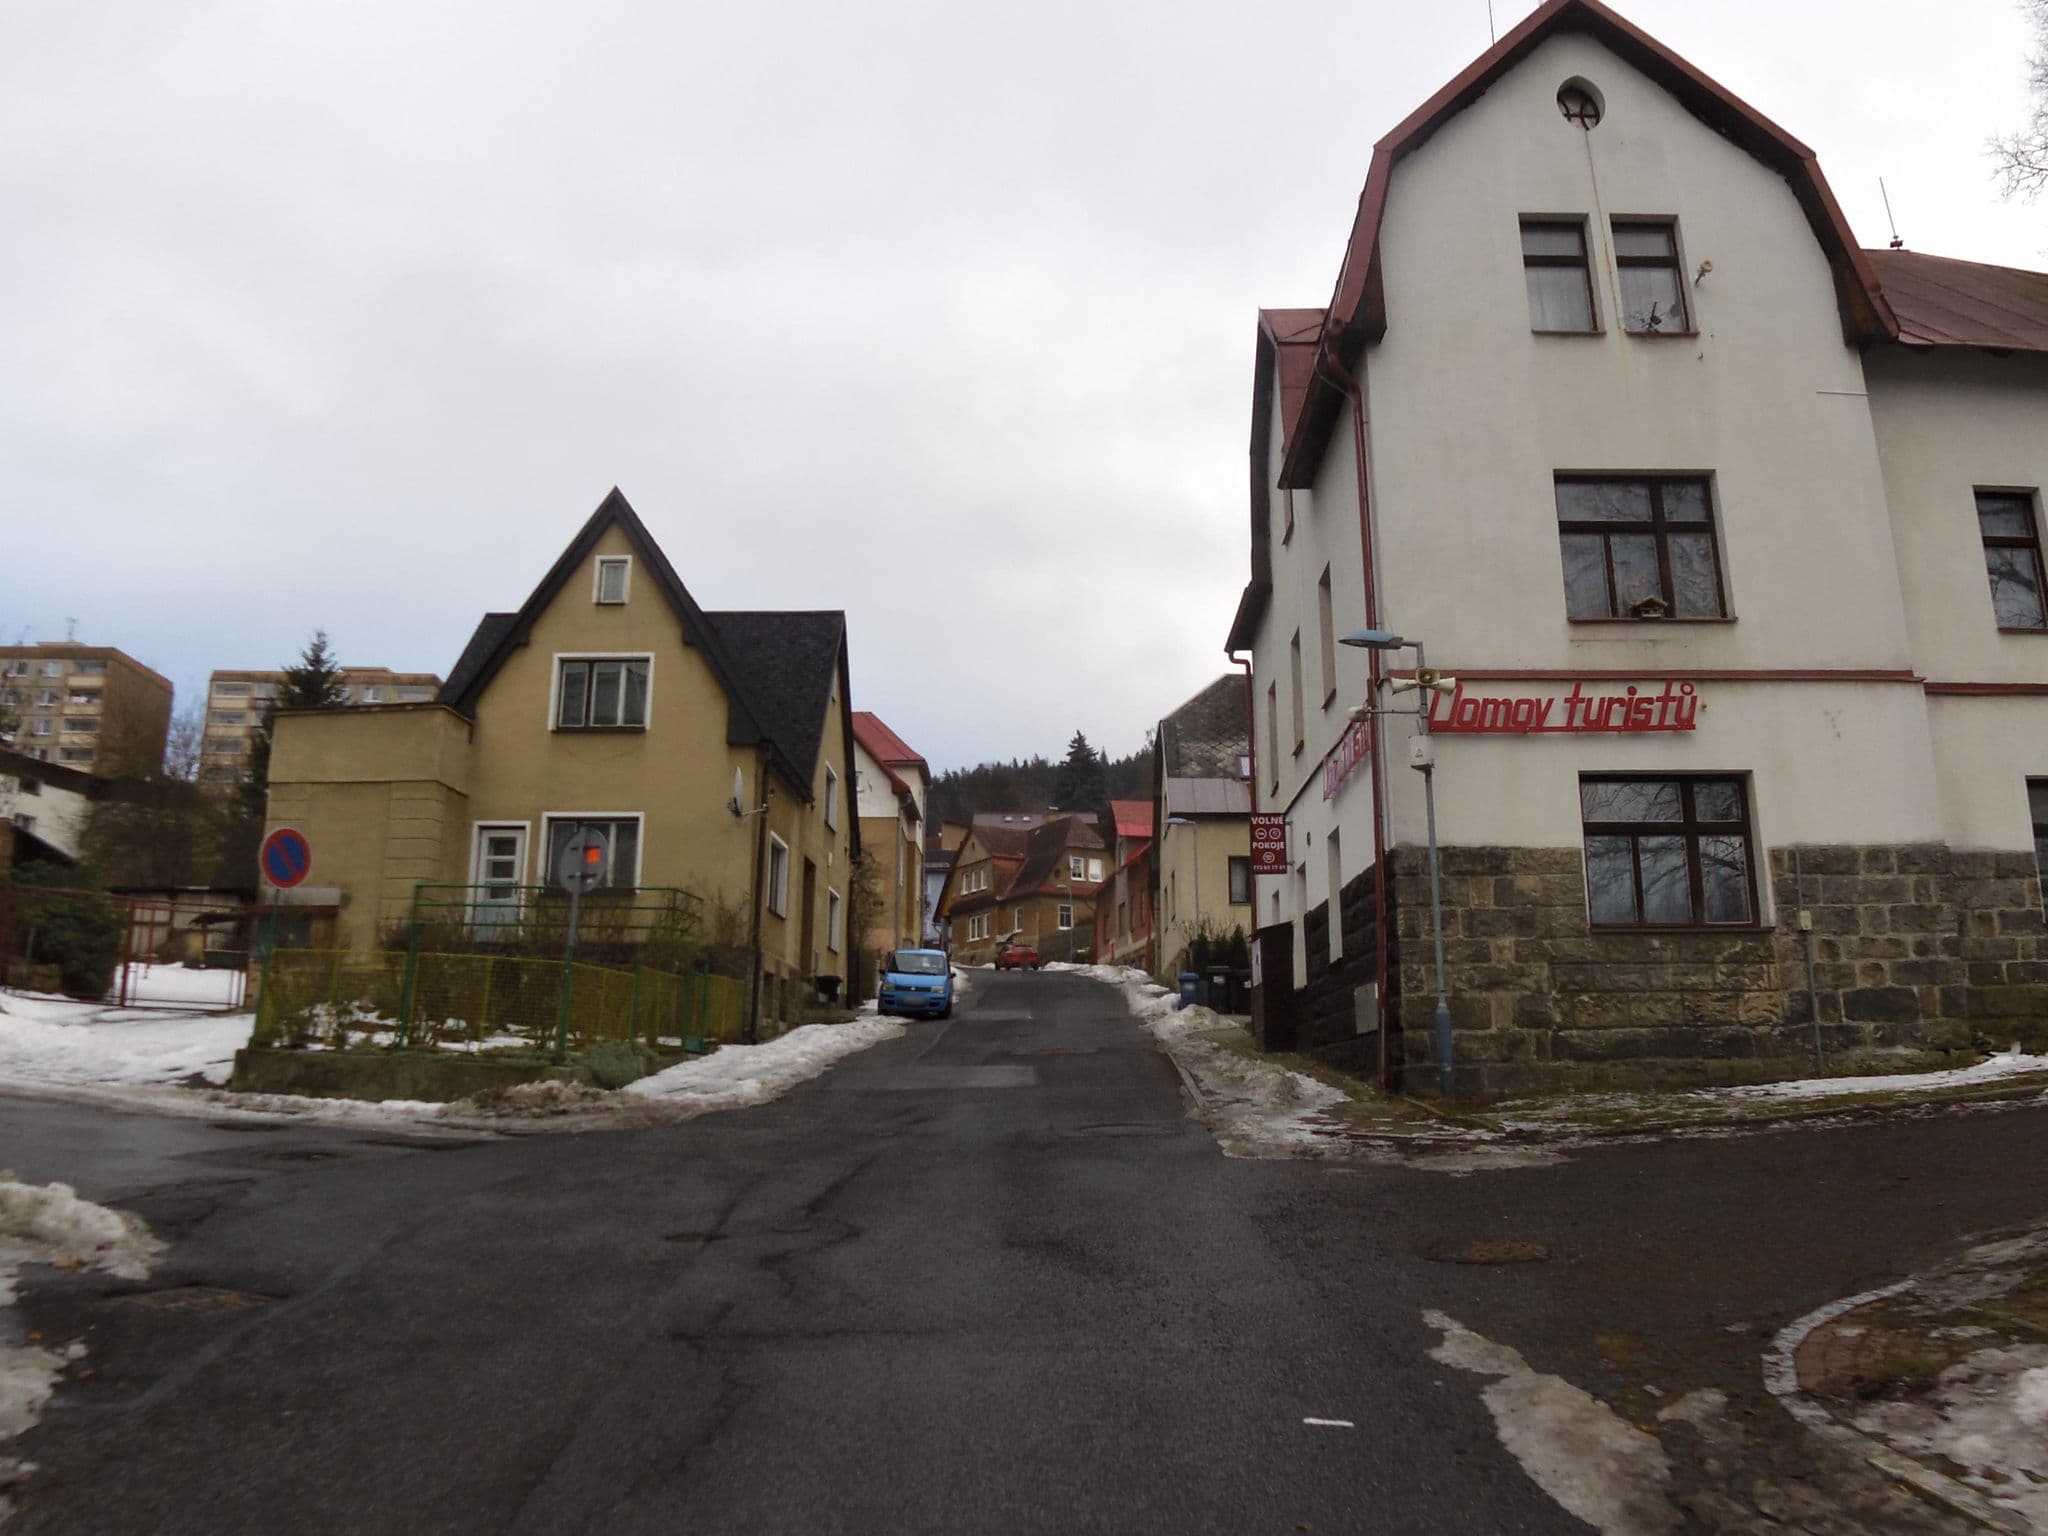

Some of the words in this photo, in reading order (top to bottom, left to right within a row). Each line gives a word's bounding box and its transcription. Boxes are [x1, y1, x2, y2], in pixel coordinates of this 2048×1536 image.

[1429, 681, 1554, 729] Domov
[1564, 680, 1697, 729] turistů
[1251, 815, 1285, 825] VOLNÉ
[1252, 841, 1285, 850] POKOJE
